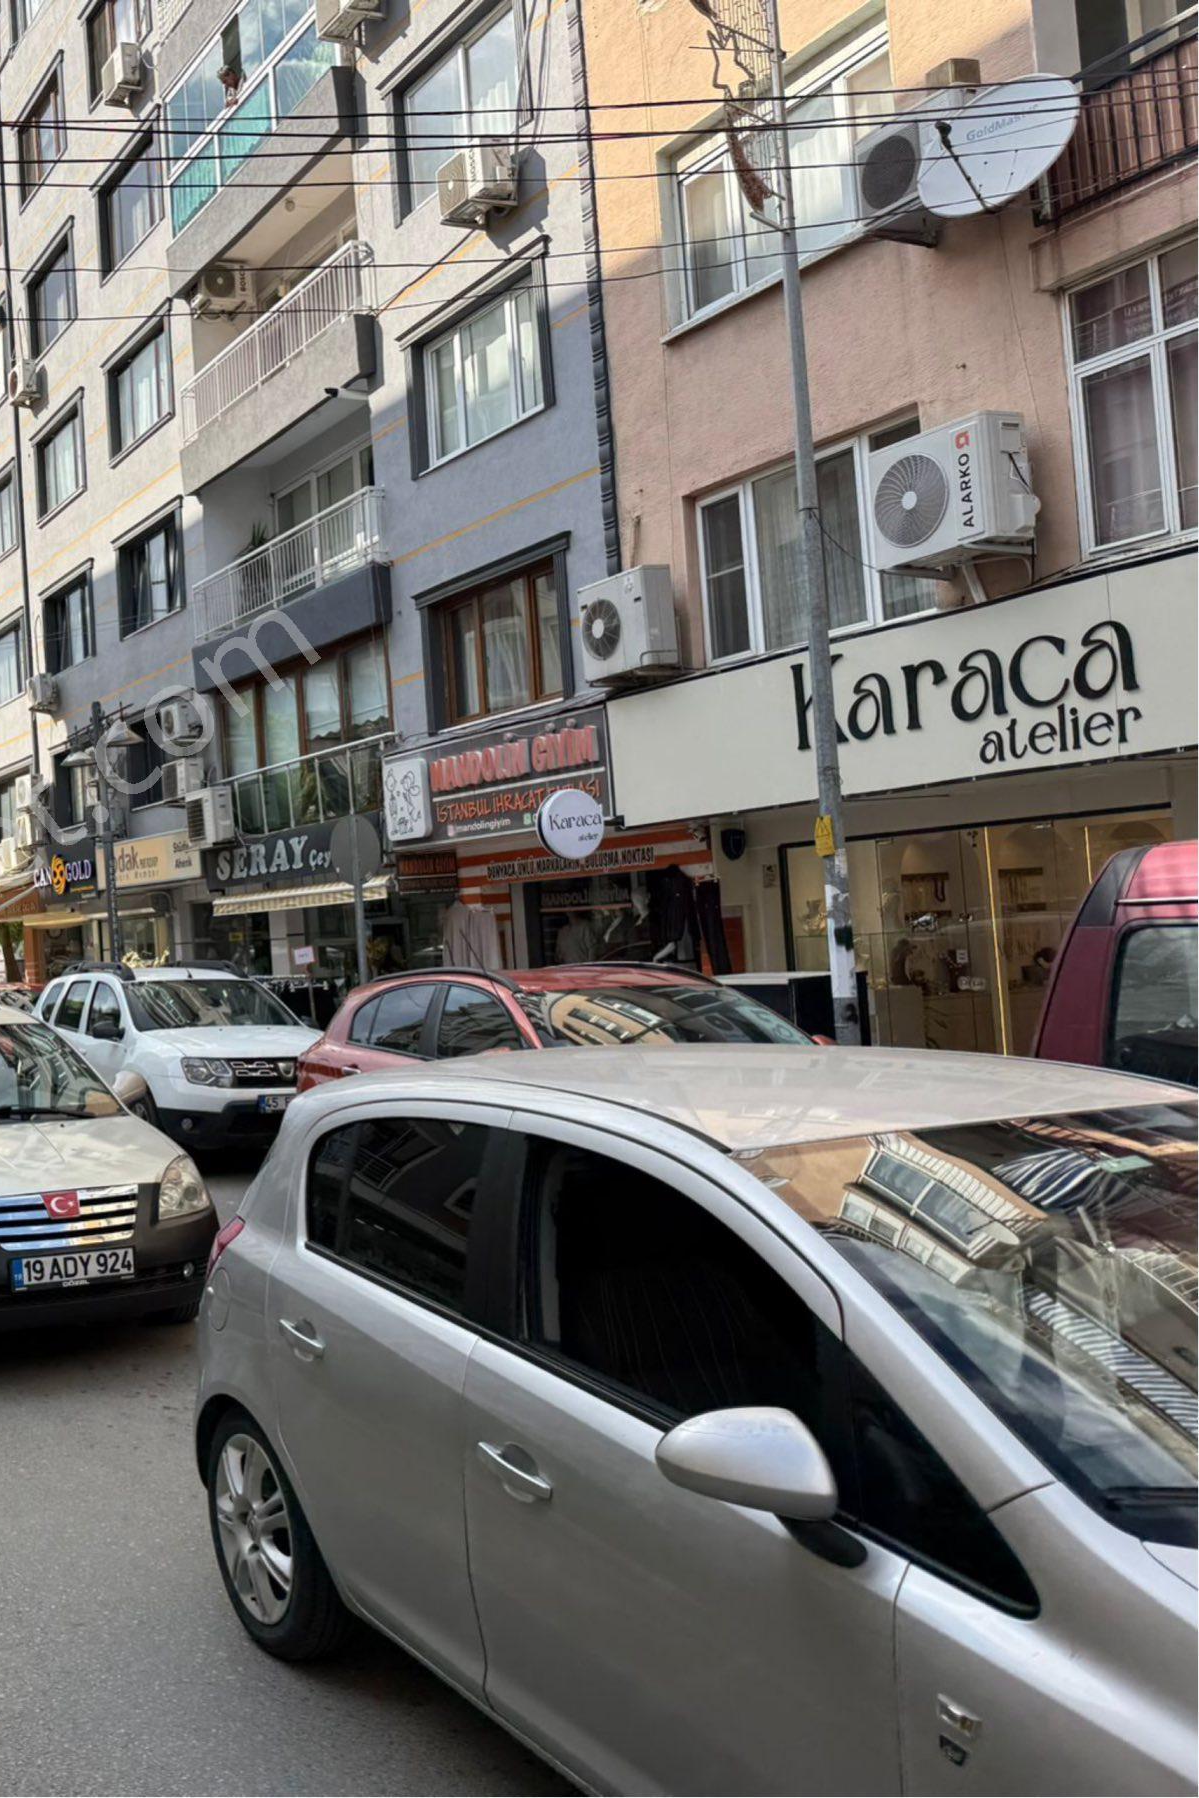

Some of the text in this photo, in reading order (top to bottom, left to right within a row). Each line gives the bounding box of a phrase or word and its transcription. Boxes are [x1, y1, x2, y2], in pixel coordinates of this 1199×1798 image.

[957, 453, 975, 527] ALARKO
[790, 620, 1140, 750] Karaca
[979, 704, 1142, 764] atelier
[430, 732, 530, 792] MANDOLİN
[436, 798, 491, 823] İSTANBUL
[492, 788, 547, 813] İHRACAT
[549, 813, 602, 831] Karaca
[34, 859, 92, 887] CAN GOLD
[216, 835, 331, 881] SERAY Çey
[24, 1250, 132, 1282] 19 ADY 924
